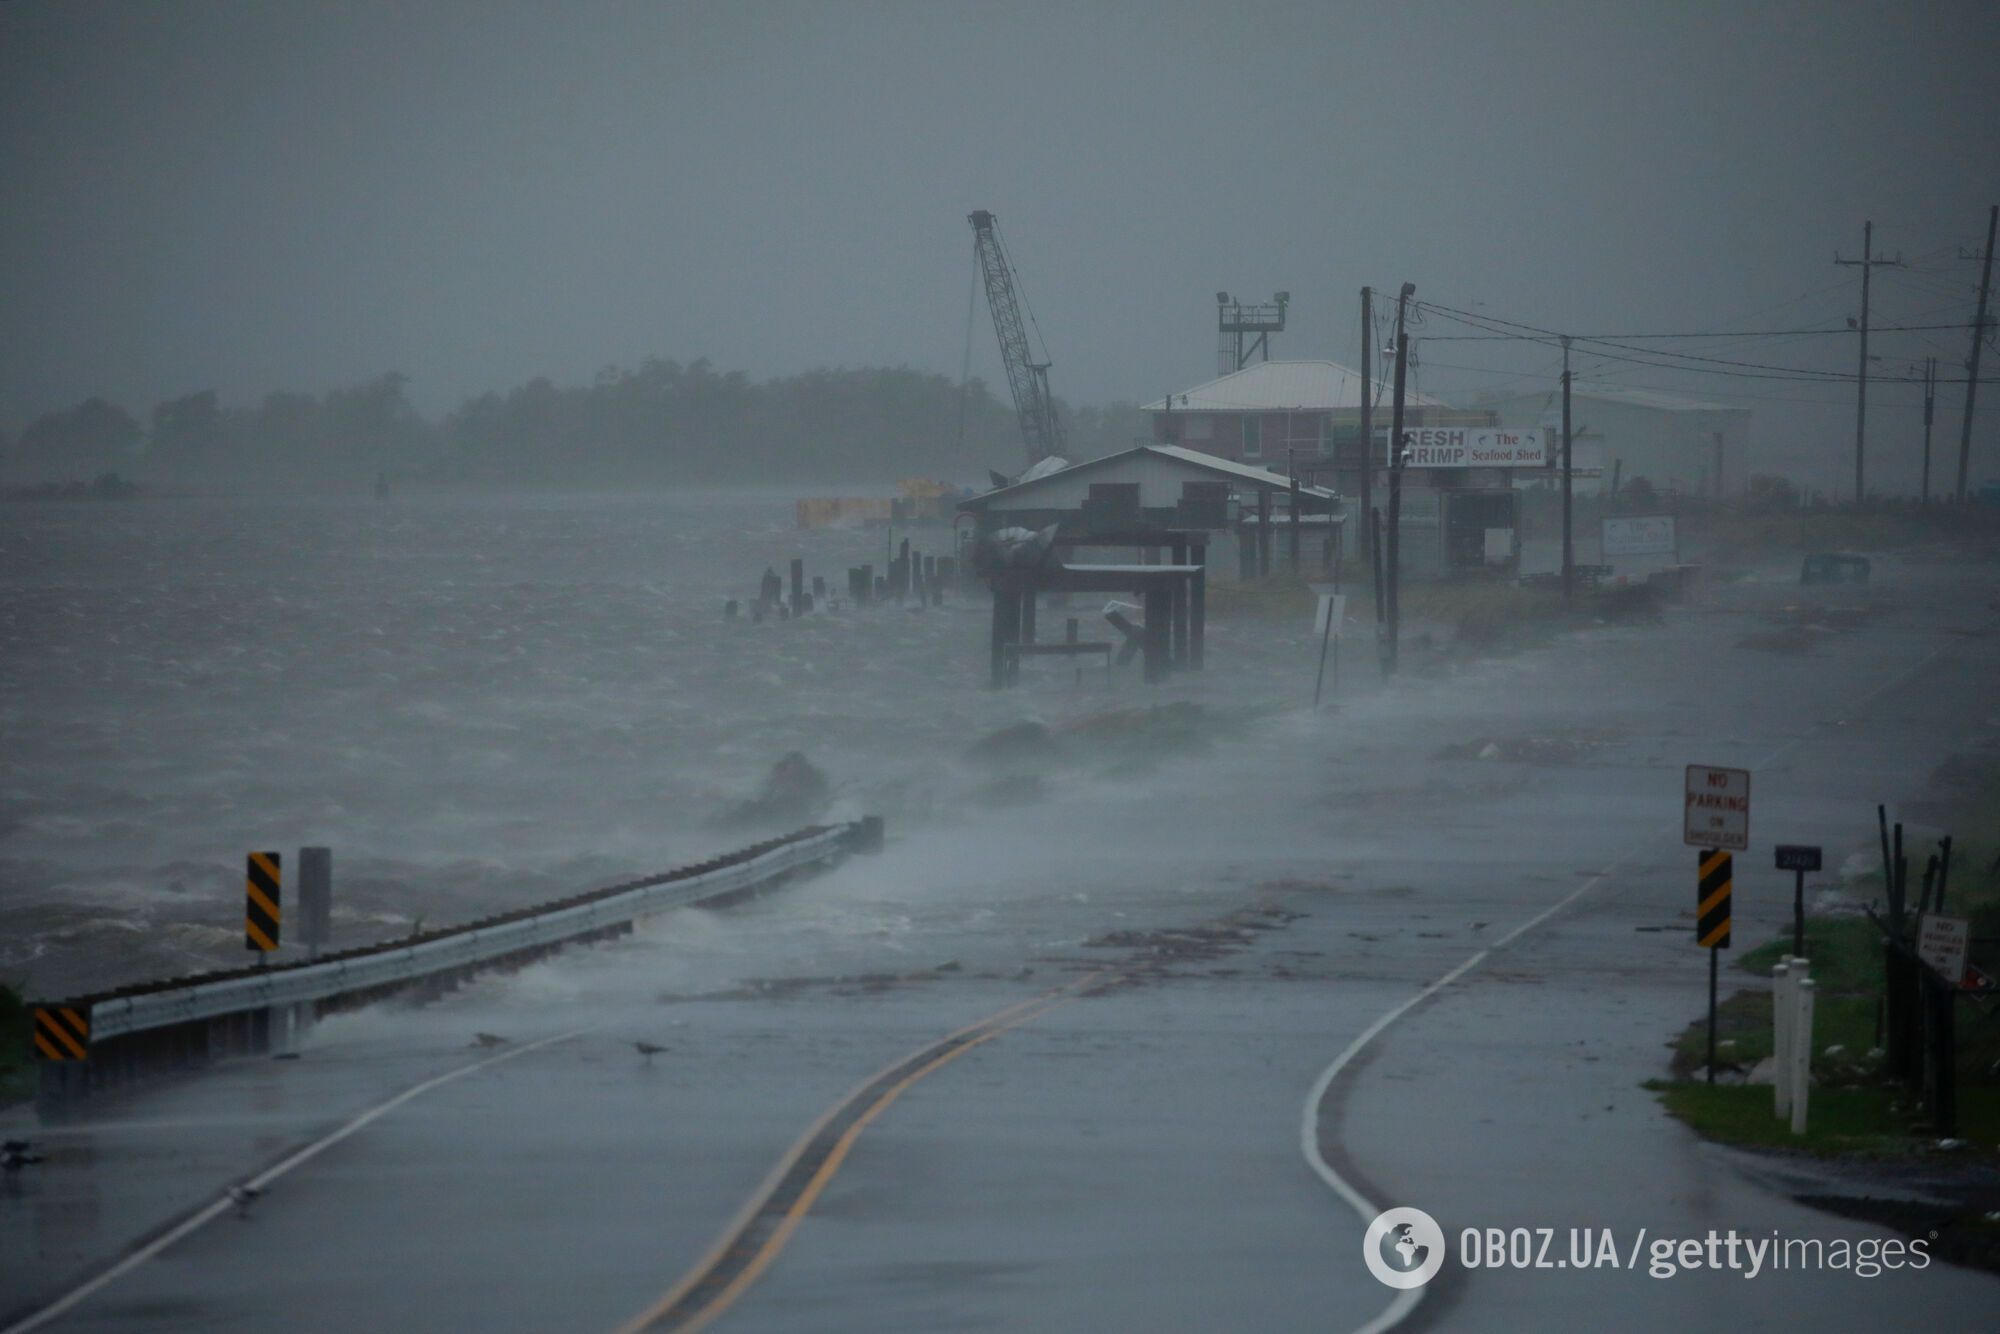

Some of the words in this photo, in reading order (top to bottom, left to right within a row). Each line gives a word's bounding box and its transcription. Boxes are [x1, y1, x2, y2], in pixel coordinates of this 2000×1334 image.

[1405, 430, 1464, 446] RESH
[1495, 433, 1519, 445] The
[1405, 448, 1464, 464] HRIMP
[1472, 451, 1512, 461] Seafood
[1517, 450, 1541, 460] Shed
[1707, 772, 1728, 788] NO
[1687, 790, 1747, 812] PARKING
[1936, 921, 1955, 932] NO
